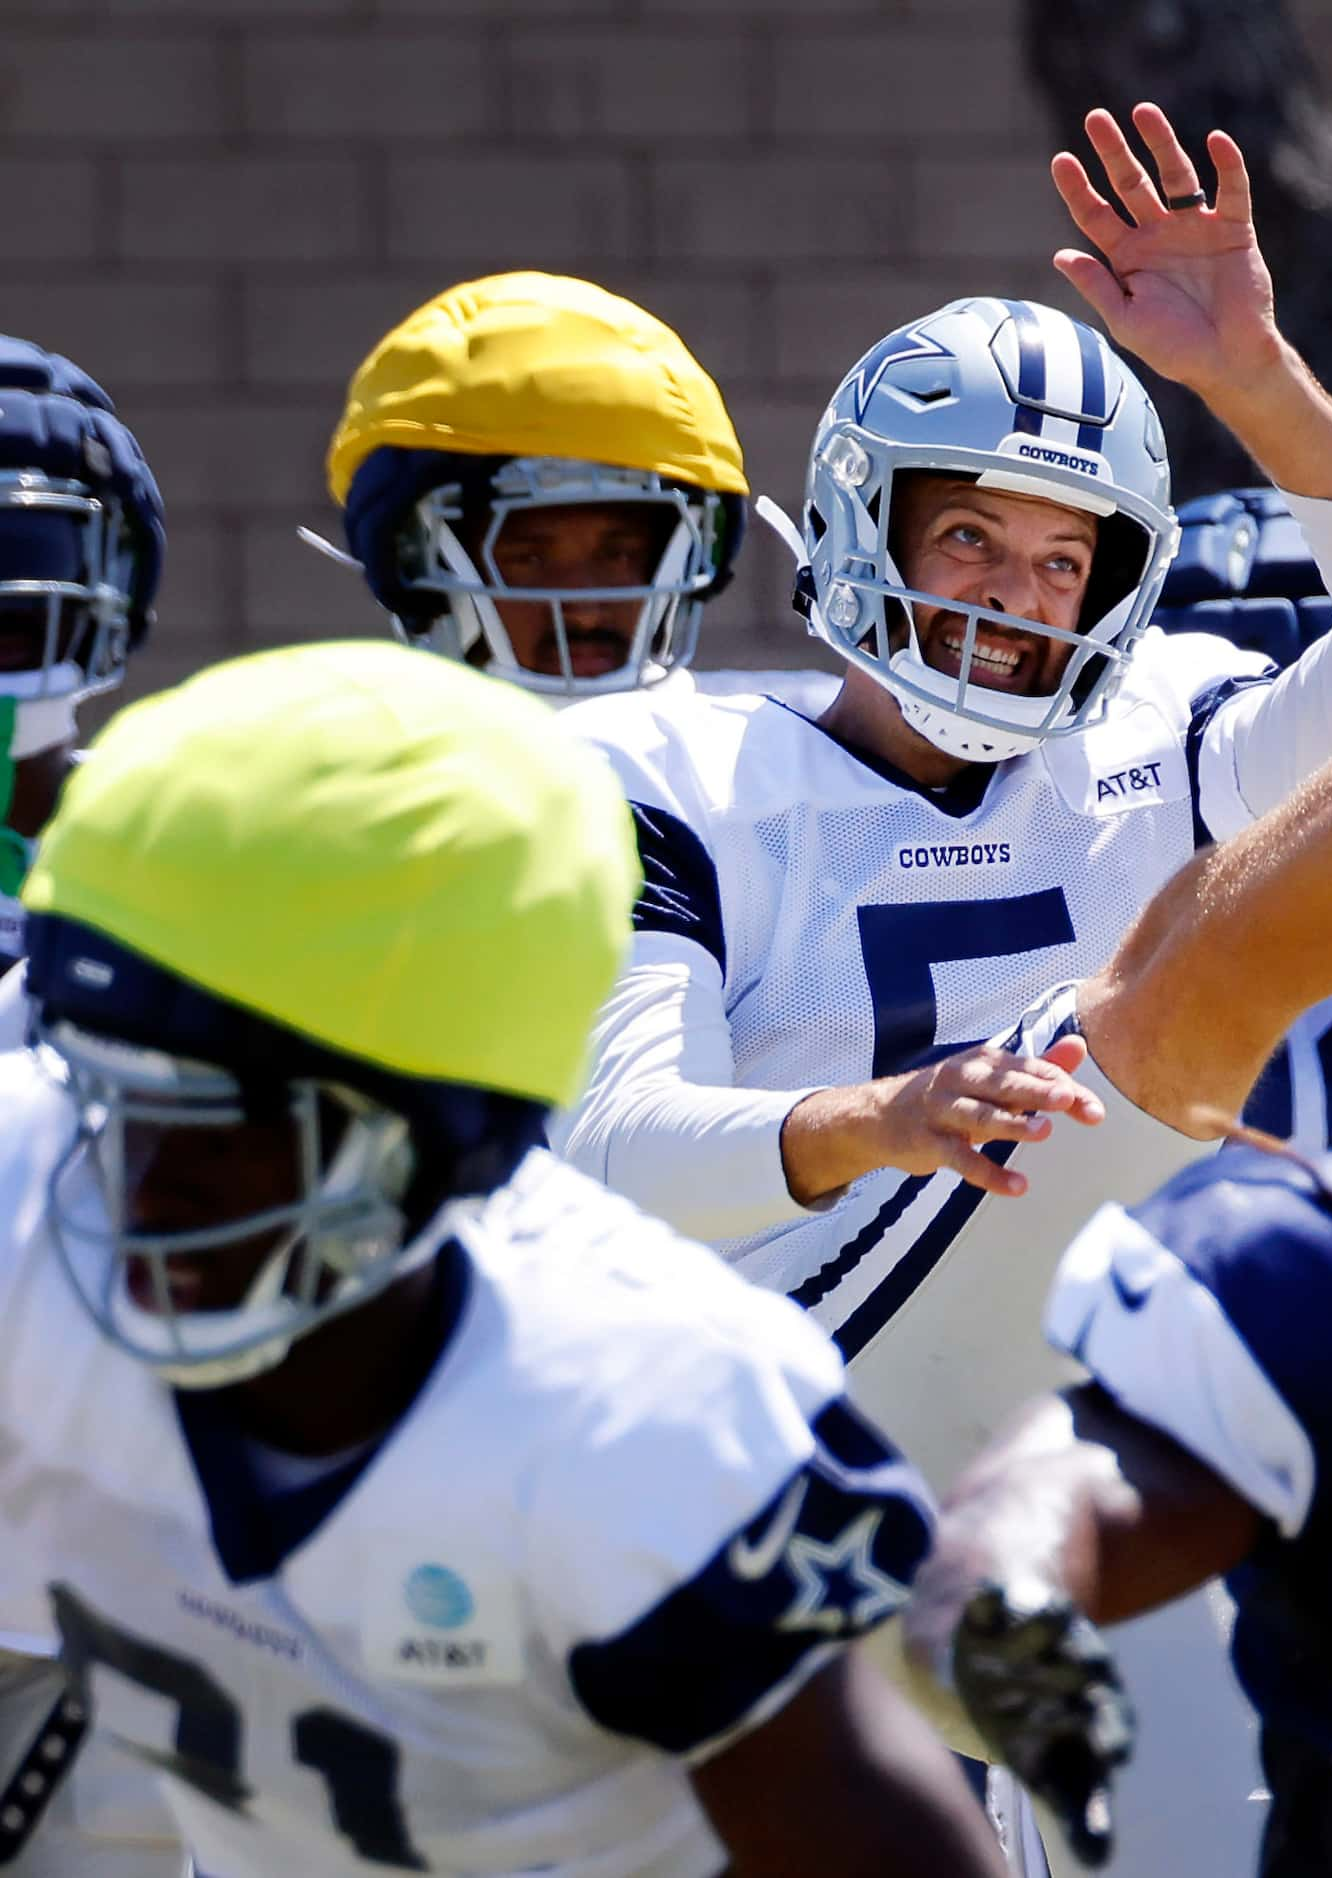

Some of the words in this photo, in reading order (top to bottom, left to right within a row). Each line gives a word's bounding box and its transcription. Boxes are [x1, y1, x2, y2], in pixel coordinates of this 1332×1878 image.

[1019, 445, 1098, 476] COWBOYS
[1096, 762, 1162, 802] AT&T
[899, 844, 1011, 868] COWBOYS
